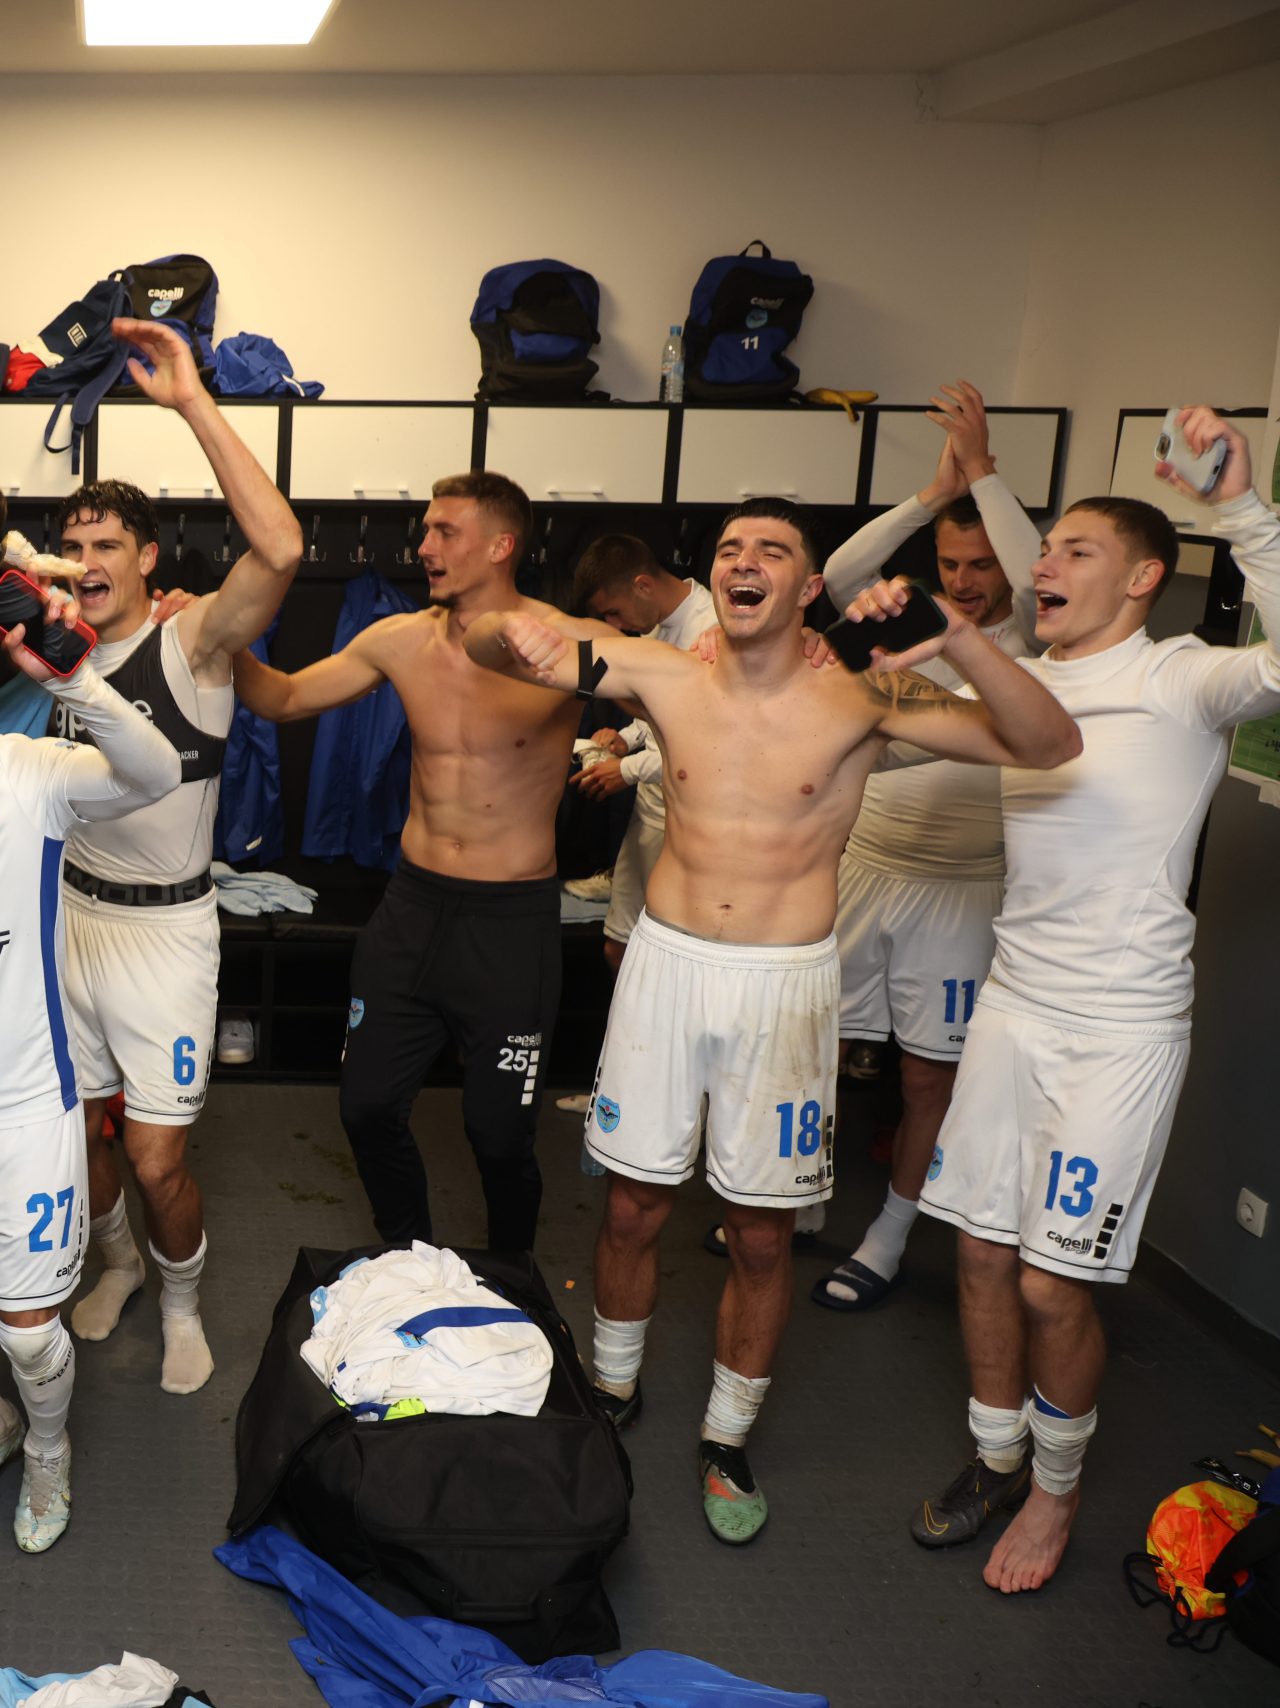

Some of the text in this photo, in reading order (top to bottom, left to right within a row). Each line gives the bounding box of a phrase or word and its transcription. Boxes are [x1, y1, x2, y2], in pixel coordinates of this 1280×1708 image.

[148, 287, 184, 300] capelli
[741, 336, 759, 350] 11
[942, 978, 976, 1024] 11
[173, 1035, 196, 1086] 6
[497, 1047, 529, 1072] 25
[776, 1100, 821, 1158] 18
[1044, 1150, 1099, 1218] 13
[26, 1185, 75, 1253] 27
[1046, 1230, 1093, 1251] capelli
